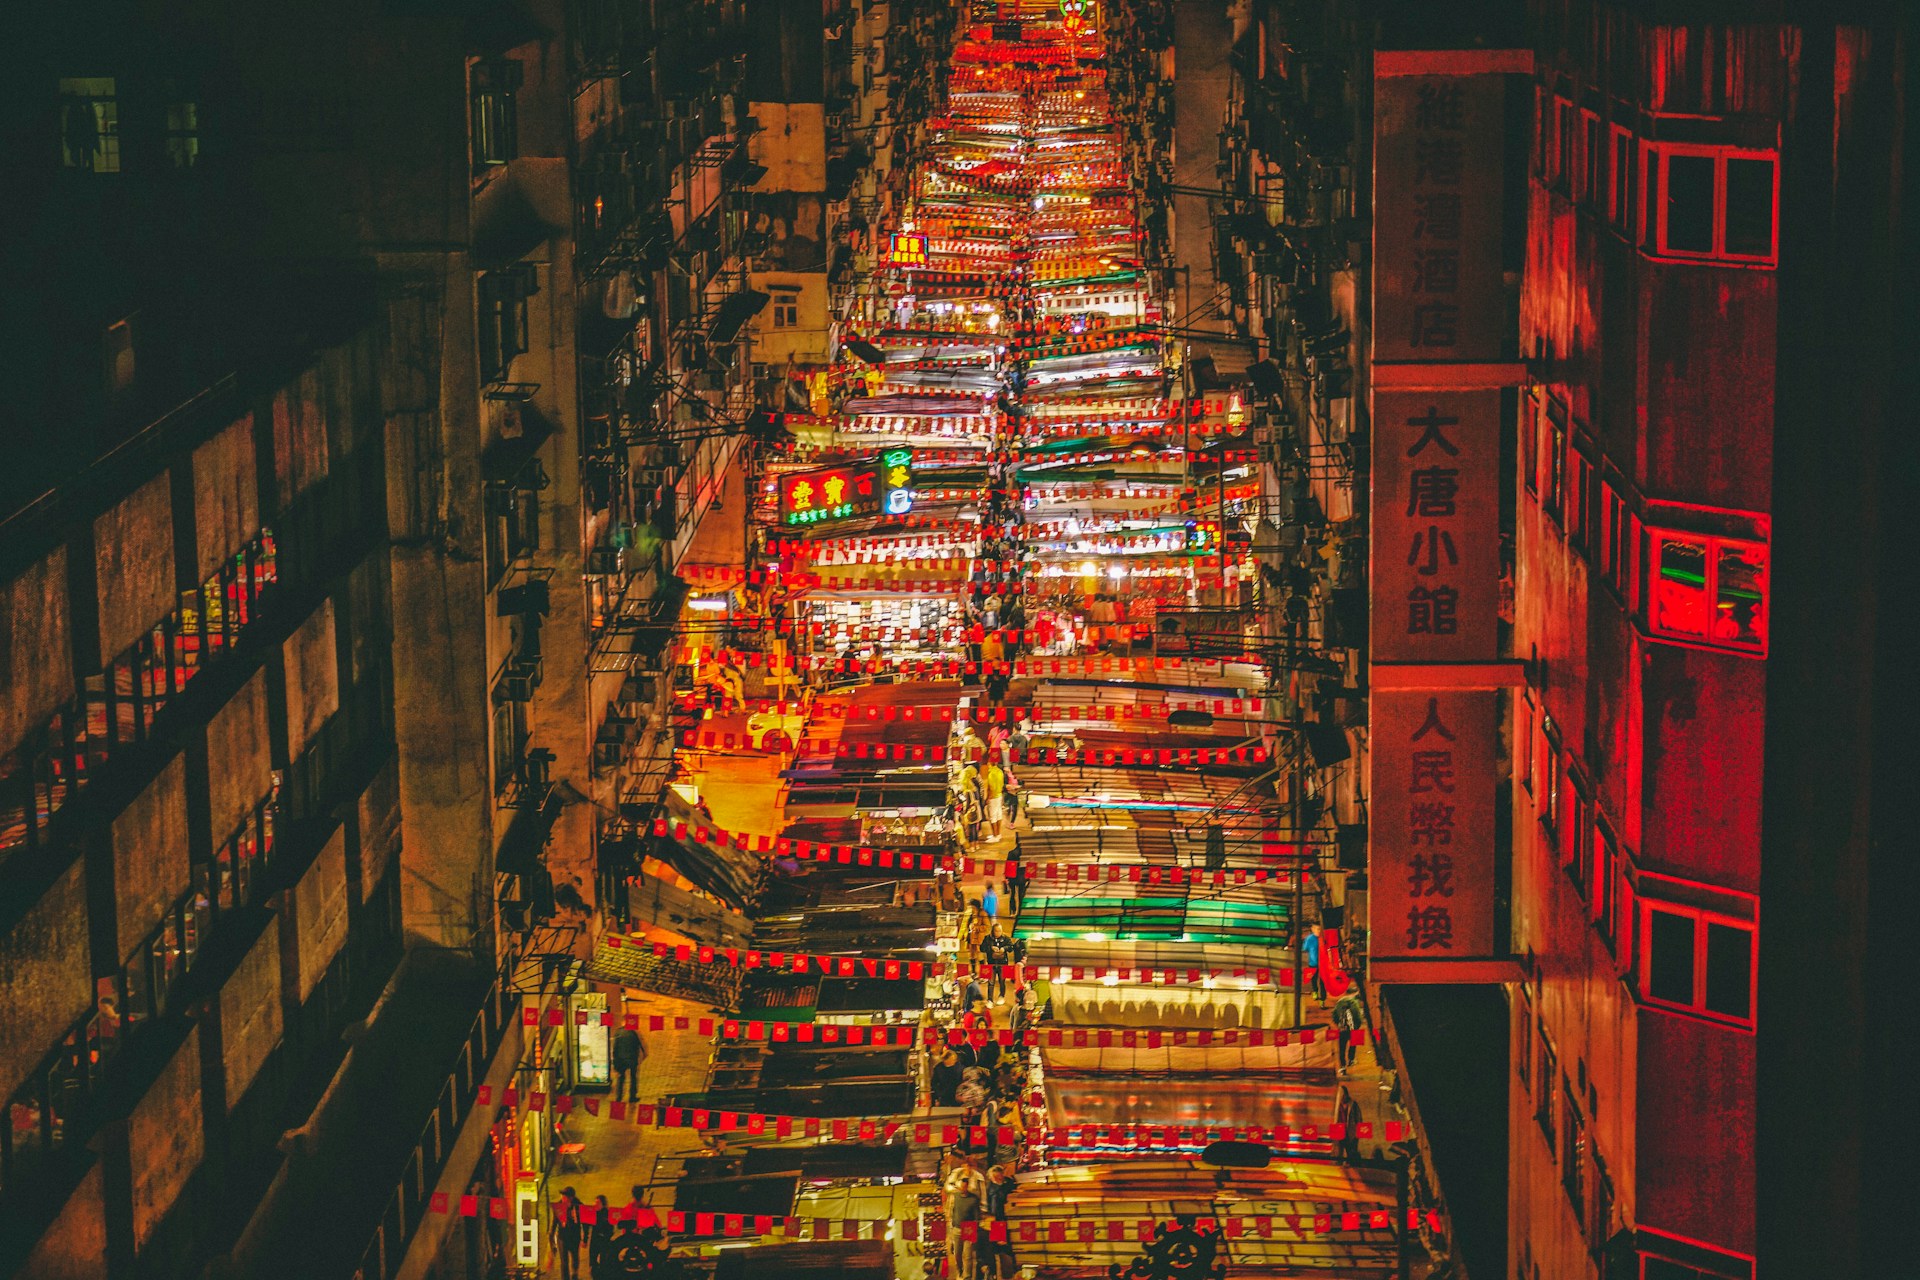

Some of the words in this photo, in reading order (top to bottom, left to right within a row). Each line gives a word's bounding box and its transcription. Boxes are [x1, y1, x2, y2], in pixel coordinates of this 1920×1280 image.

[1406, 406, 1460, 636] 大唐小館
[1406, 696, 1456, 950] 人民幣找換
